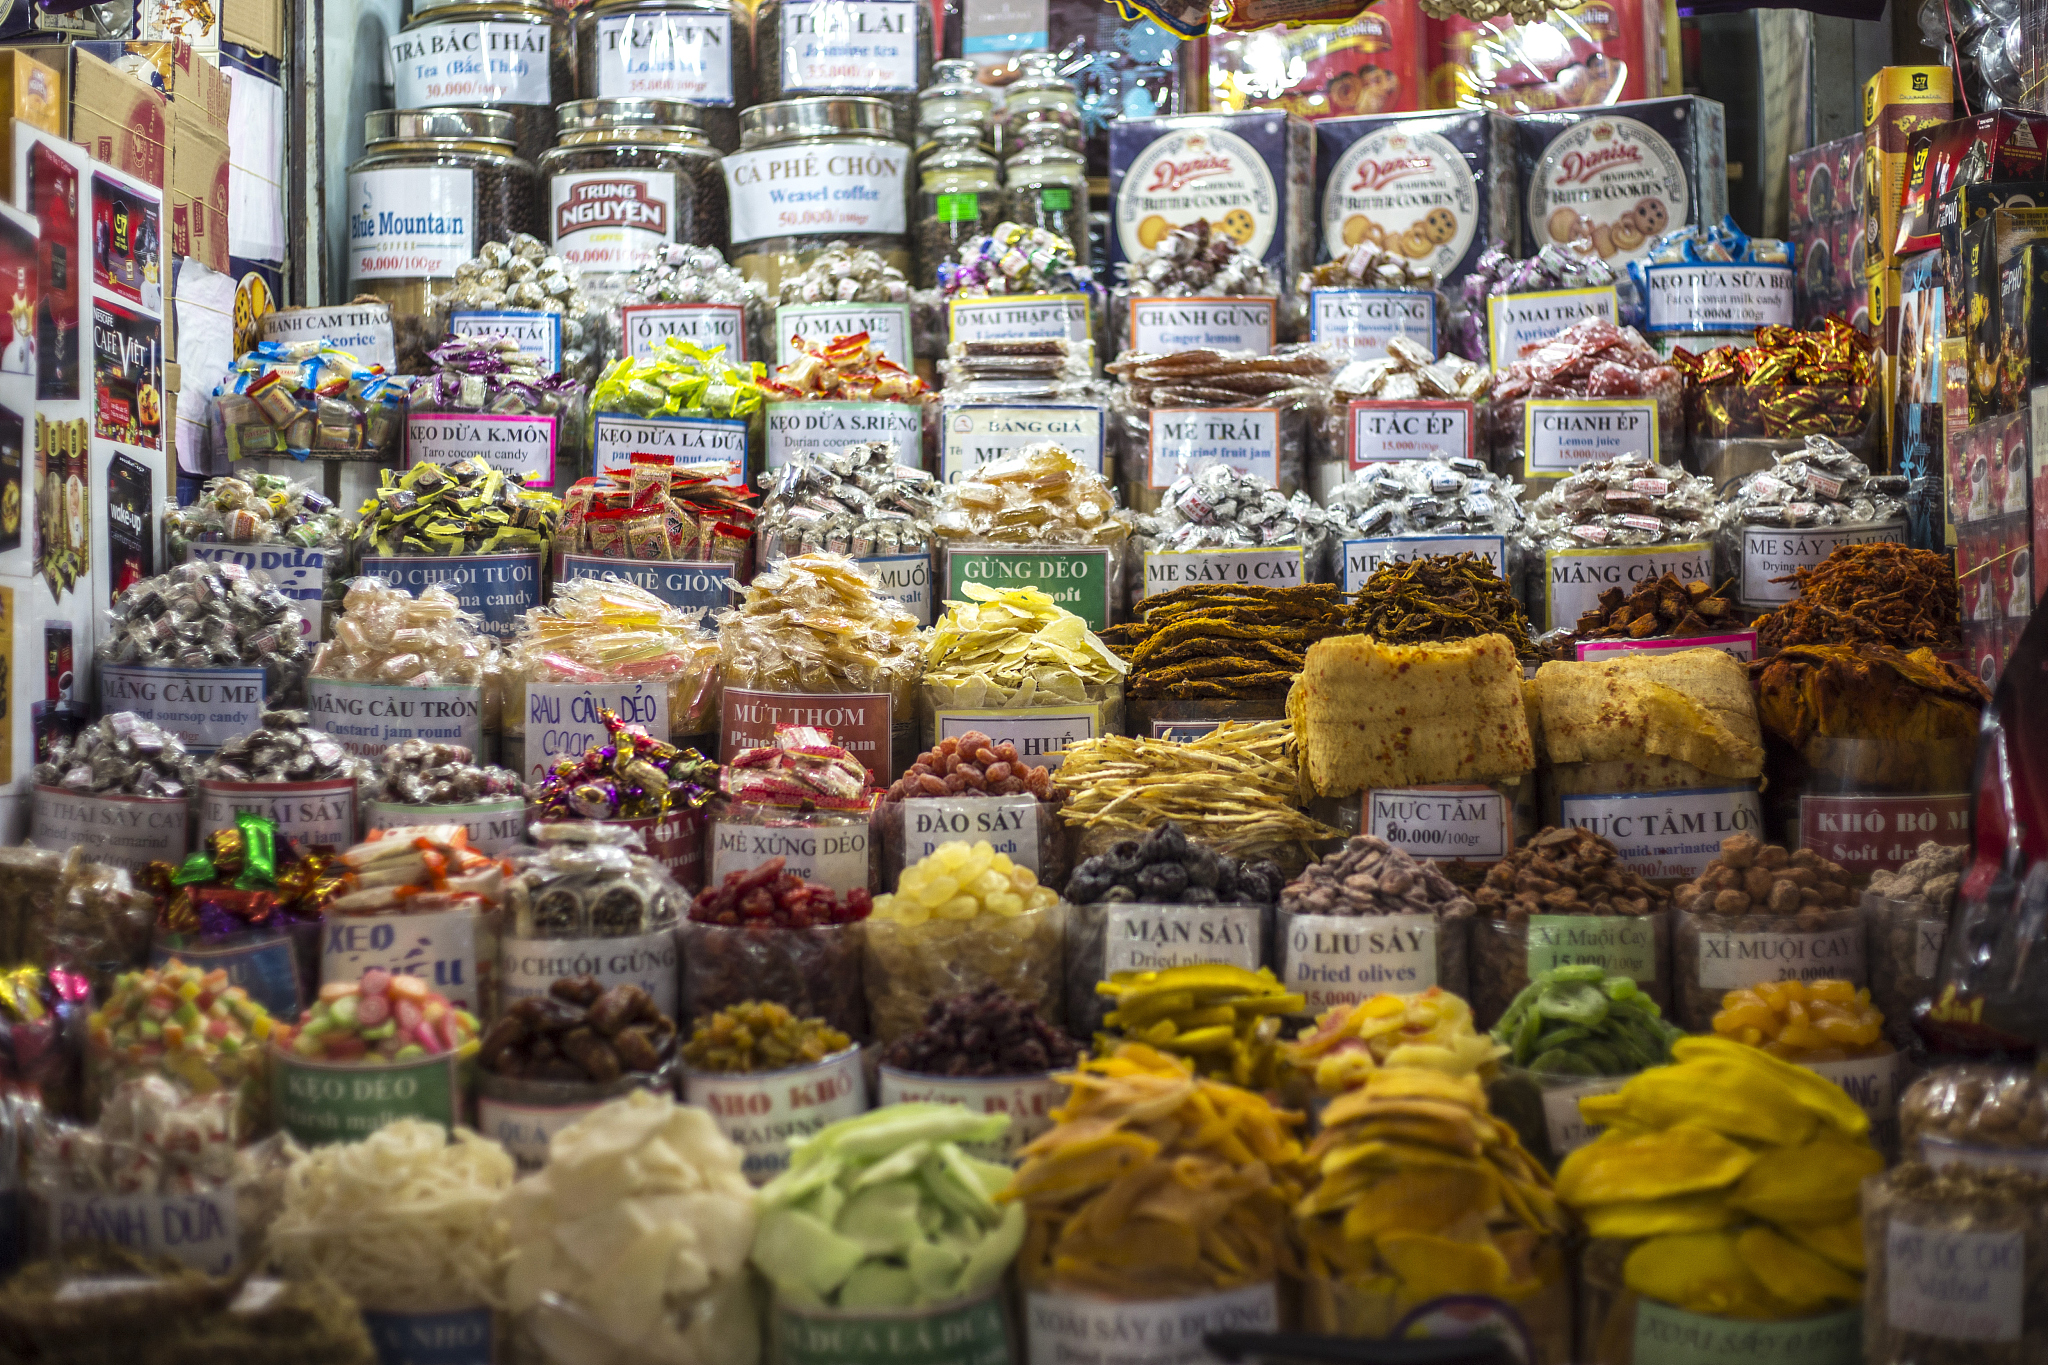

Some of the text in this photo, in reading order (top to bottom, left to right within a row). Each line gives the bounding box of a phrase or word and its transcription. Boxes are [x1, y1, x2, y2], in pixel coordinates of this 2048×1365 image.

[857, 7, 905, 34] LÀI
[392, 28, 546, 63] TRÀ BẮC THÁI
[415, 55, 482, 80] Tea (Bắc
[768, 152, 820, 181] PHÊ
[1554, 138, 1644, 186] Danisa
[1912, 147, 1929, 172] G7
[1147, 151, 1234, 192] Danisa
[577, 183, 638, 201] TRUNG
[769, 184, 880, 206] Weasel coffee
[1603, 183, 1663, 200] COOKIES
[351, 210, 464, 240] Blue Mountain
[376, 241, 417, 252] COFFEE
[1651, 274, 1684, 292] KẸO
[1731, 269, 1766, 289] SỮA
[1730, 293, 1783, 308] milk candy
[306, 314, 344, 330] CAM
[813, 316, 890, 335] MAI ME
[971, 312, 1002, 326] MAI
[1138, 310, 1208, 327] CHANH
[1518, 306, 1551, 324] MAI
[658, 320, 698, 337] MAI
[1159, 332, 1242, 347] Ginger lemon
[410, 418, 549, 445] KẸO DỪA K.MÔN
[770, 410, 918, 436] KẸO DỪA S.RIÊNG
[1047, 418, 1082, 433] GIÁ
[1162, 416, 1262, 441] ME TRÁI
[1426, 409, 1454, 435] ÉP
[1542, 411, 1640, 432] CHANH ÉP
[599, 428, 632, 449] KẸO
[637, 427, 677, 447] DỪA
[681, 428, 706, 449] LÁ
[784, 436, 868, 448] Durian coconut
[1558, 435, 1621, 449] Lemon juice
[422, 447, 529, 463] Taro coconut candy
[1220, 446, 1272, 461] fruit jam
[1750, 536, 1826, 556] ME SẤY
[482, 563, 533, 583] TƯƠI
[964, 555, 1089, 579] GỪNG DẺO
[1148, 558, 1300, 582] ME SẤY CAY
[1349, 554, 1381, 574] ME
[1551, 561, 1622, 585] MÃNG
[1762, 560, 1797, 573] Drying
[624, 567, 725, 593] MÈ GIÒN
[486, 590, 534, 609] candy
[898, 590, 923, 604] salt
[102, 676, 259, 704] MÃNG CẦU ME
[310, 692, 479, 718] MÃNG CẦU TRÒN
[530, 693, 561, 724] RAU
[733, 699, 866, 728] MỨT THƠM
[156, 709, 249, 725] soursop candy
[325, 719, 462, 741] Custard jam round
[147, 808, 186, 830] CAY
[299, 798, 347, 823] SẤY
[916, 805, 1026, 834] ĐÀO SẤY
[1377, 800, 1431, 823] MỰC
[1713, 802, 1760, 832] LỚN
[1817, 806, 1938, 834] KHÔ BÒ
[106, 832, 169, 849] tamarind
[487, 818, 521, 841] ME
[313, 831, 342, 852] jam
[719, 831, 748, 851] MÈ
[823, 831, 866, 855] DẺO
[1653, 840, 1721, 857] marinated
[1832, 842, 1879, 862] Soft
[1199, 915, 1250, 946] SẤY
[1314, 926, 1425, 955] LIU SẤY
[1619, 926, 1649, 951] Cay
[1129, 951, 1178, 967] Dried
[1299, 962, 1417, 983] Dried olives
